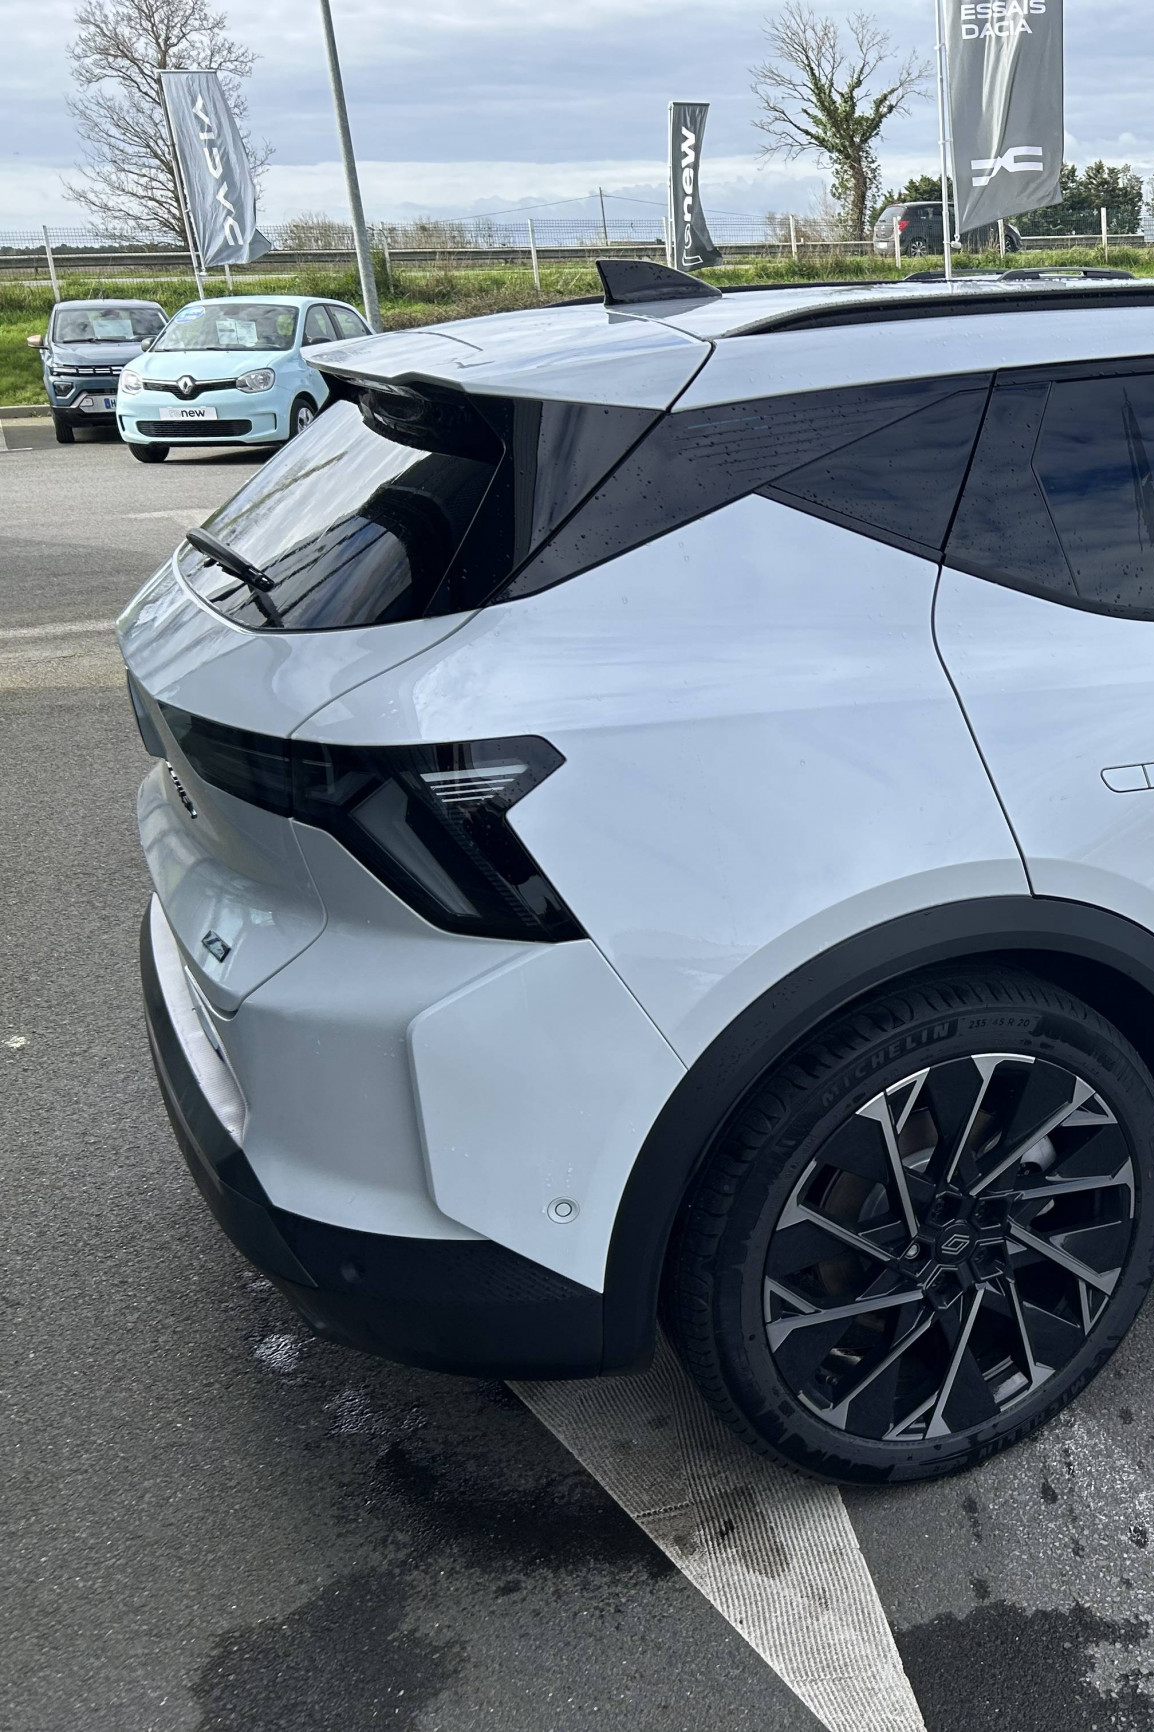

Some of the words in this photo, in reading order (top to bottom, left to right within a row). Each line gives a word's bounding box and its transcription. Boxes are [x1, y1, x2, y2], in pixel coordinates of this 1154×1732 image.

[961, 0, 1046, 20] ESSAIS
[961, 19, 1033, 39] DACIA
[681, 126, 704, 267] renew
[822, 1023, 950, 1107] MICHELIN
